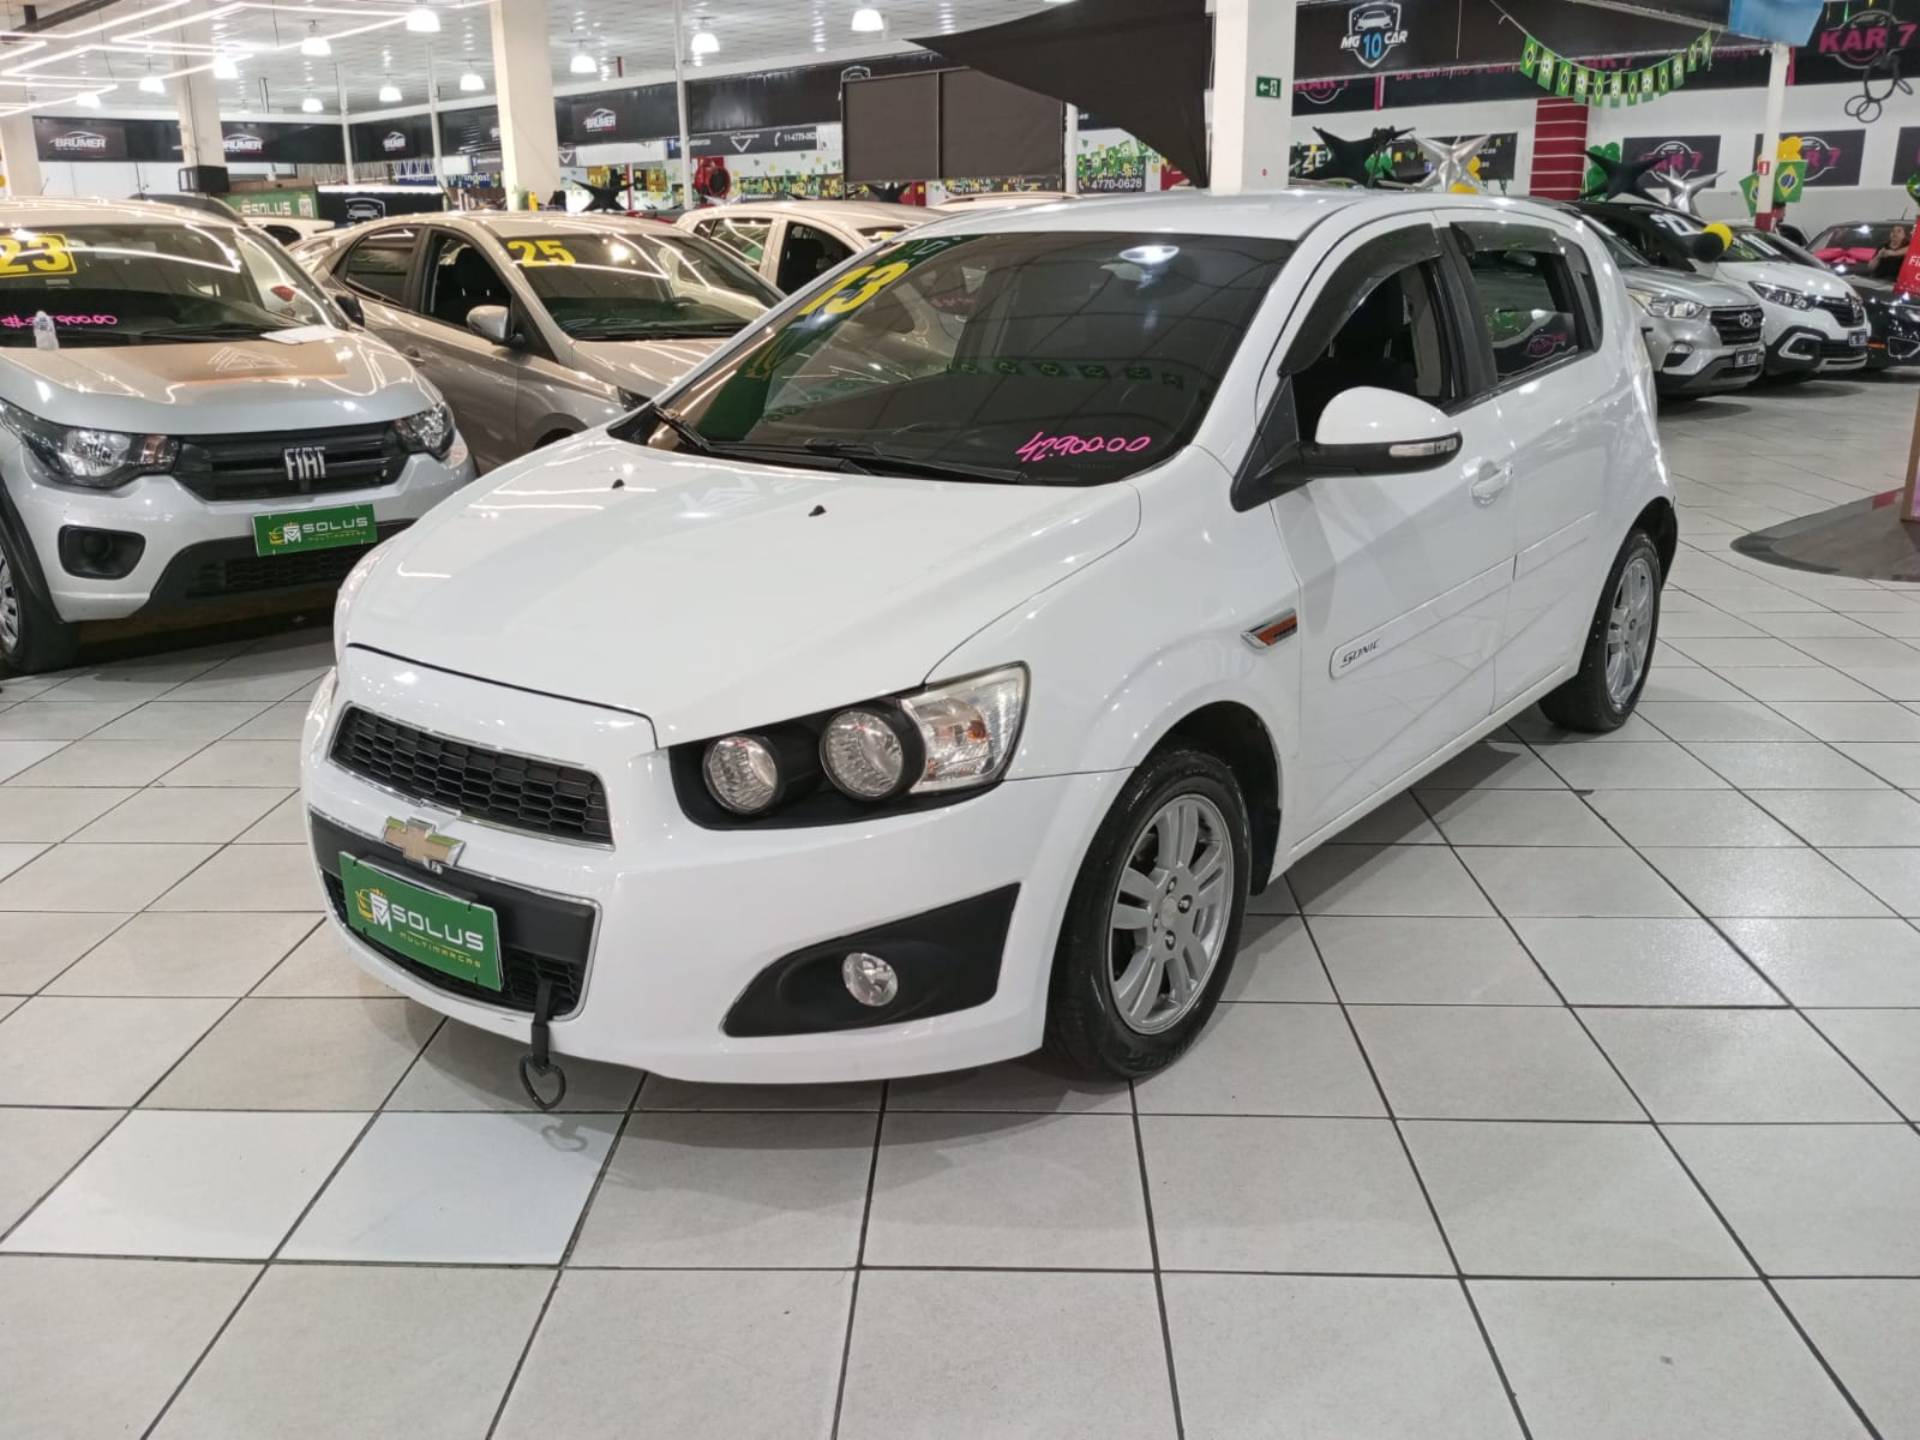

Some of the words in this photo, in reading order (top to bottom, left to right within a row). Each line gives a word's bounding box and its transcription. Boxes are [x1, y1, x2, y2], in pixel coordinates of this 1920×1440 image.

[1341, 34, 1361, 49] MG
[1363, 32, 1382, 59] 10
[1384, 30, 1409, 45] CAR
[1819, 26, 1887, 53] KAR
[1898, 23, 1917, 47] 7
[0, 236, 69, 272] 23
[507, 240, 576, 267] 25
[284, 446, 326, 480] FIAT
[302, 517, 368, 533] SOLUS
[391, 903, 484, 951] SOLUS
